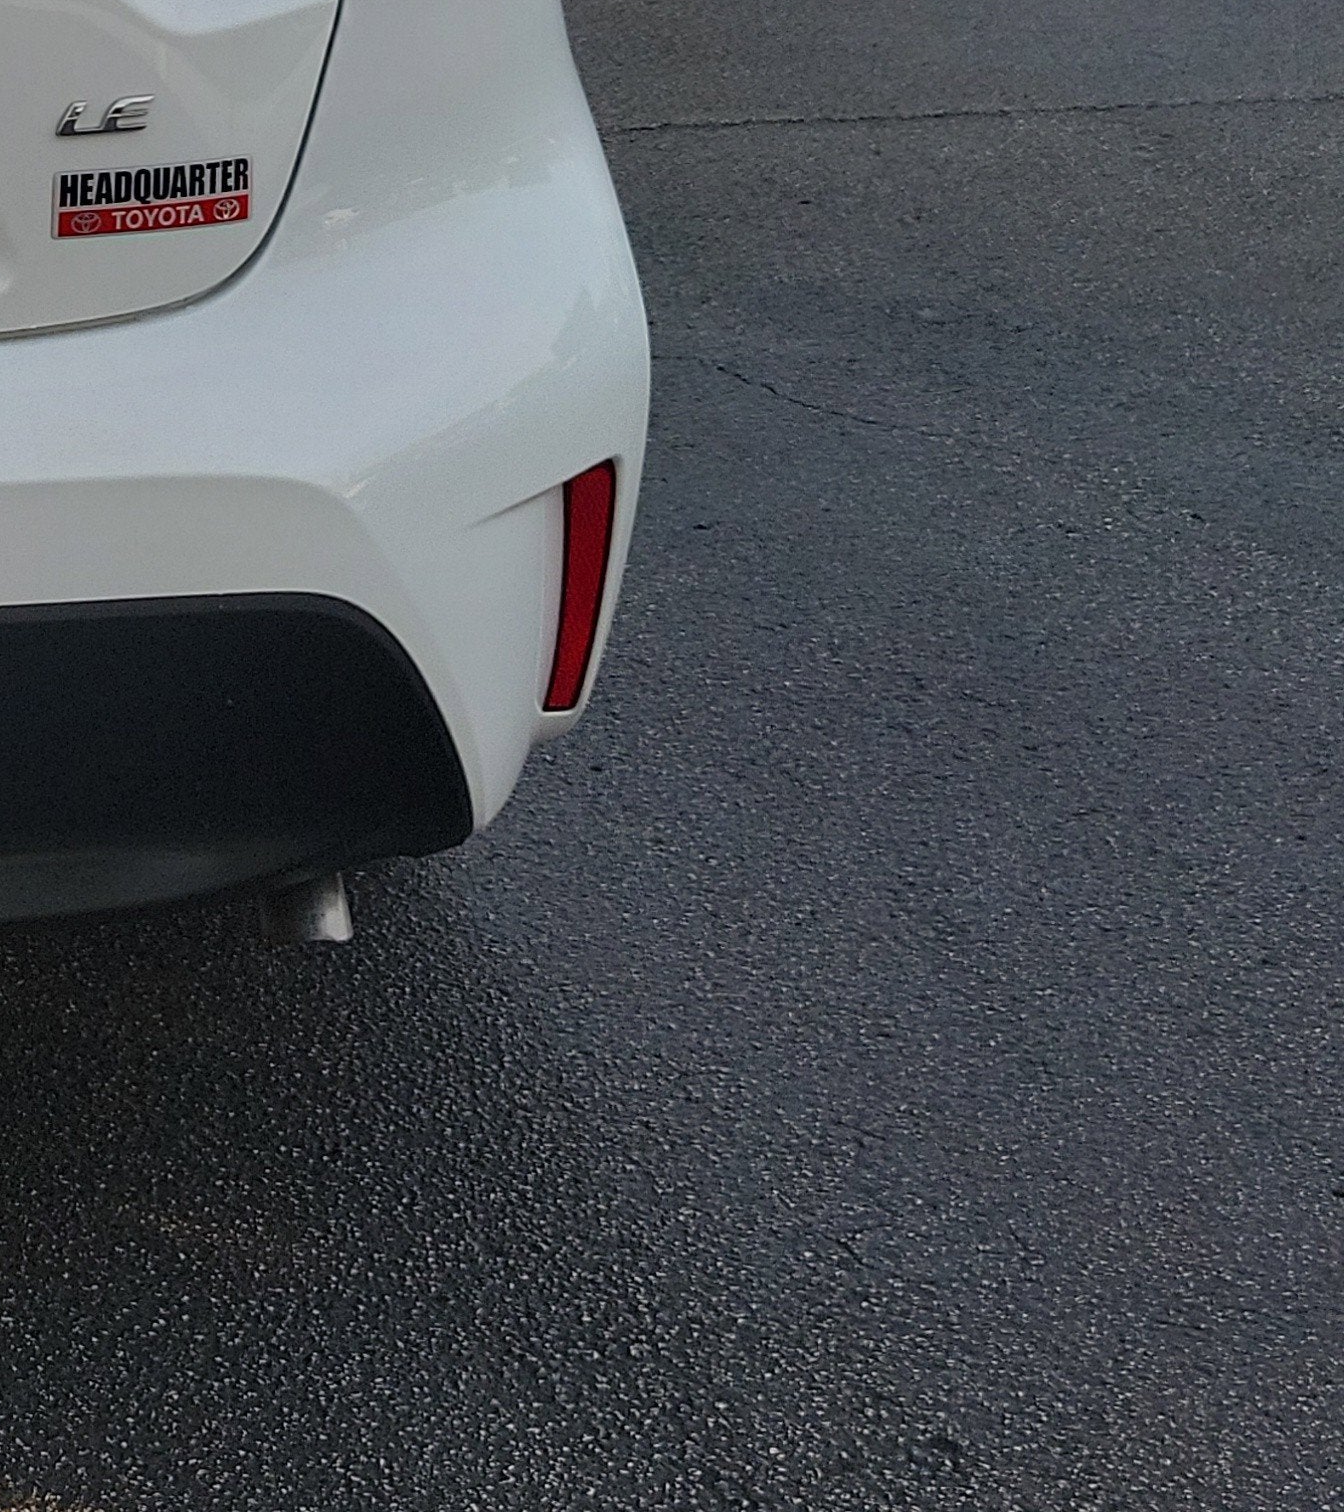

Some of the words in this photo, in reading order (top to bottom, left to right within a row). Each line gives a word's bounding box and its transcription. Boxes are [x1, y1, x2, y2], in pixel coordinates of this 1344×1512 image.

[55, 94, 155, 136] LE
[59, 158, 249, 208] HEADQUARTER
[112, 205, 205, 230] TOYOTA
